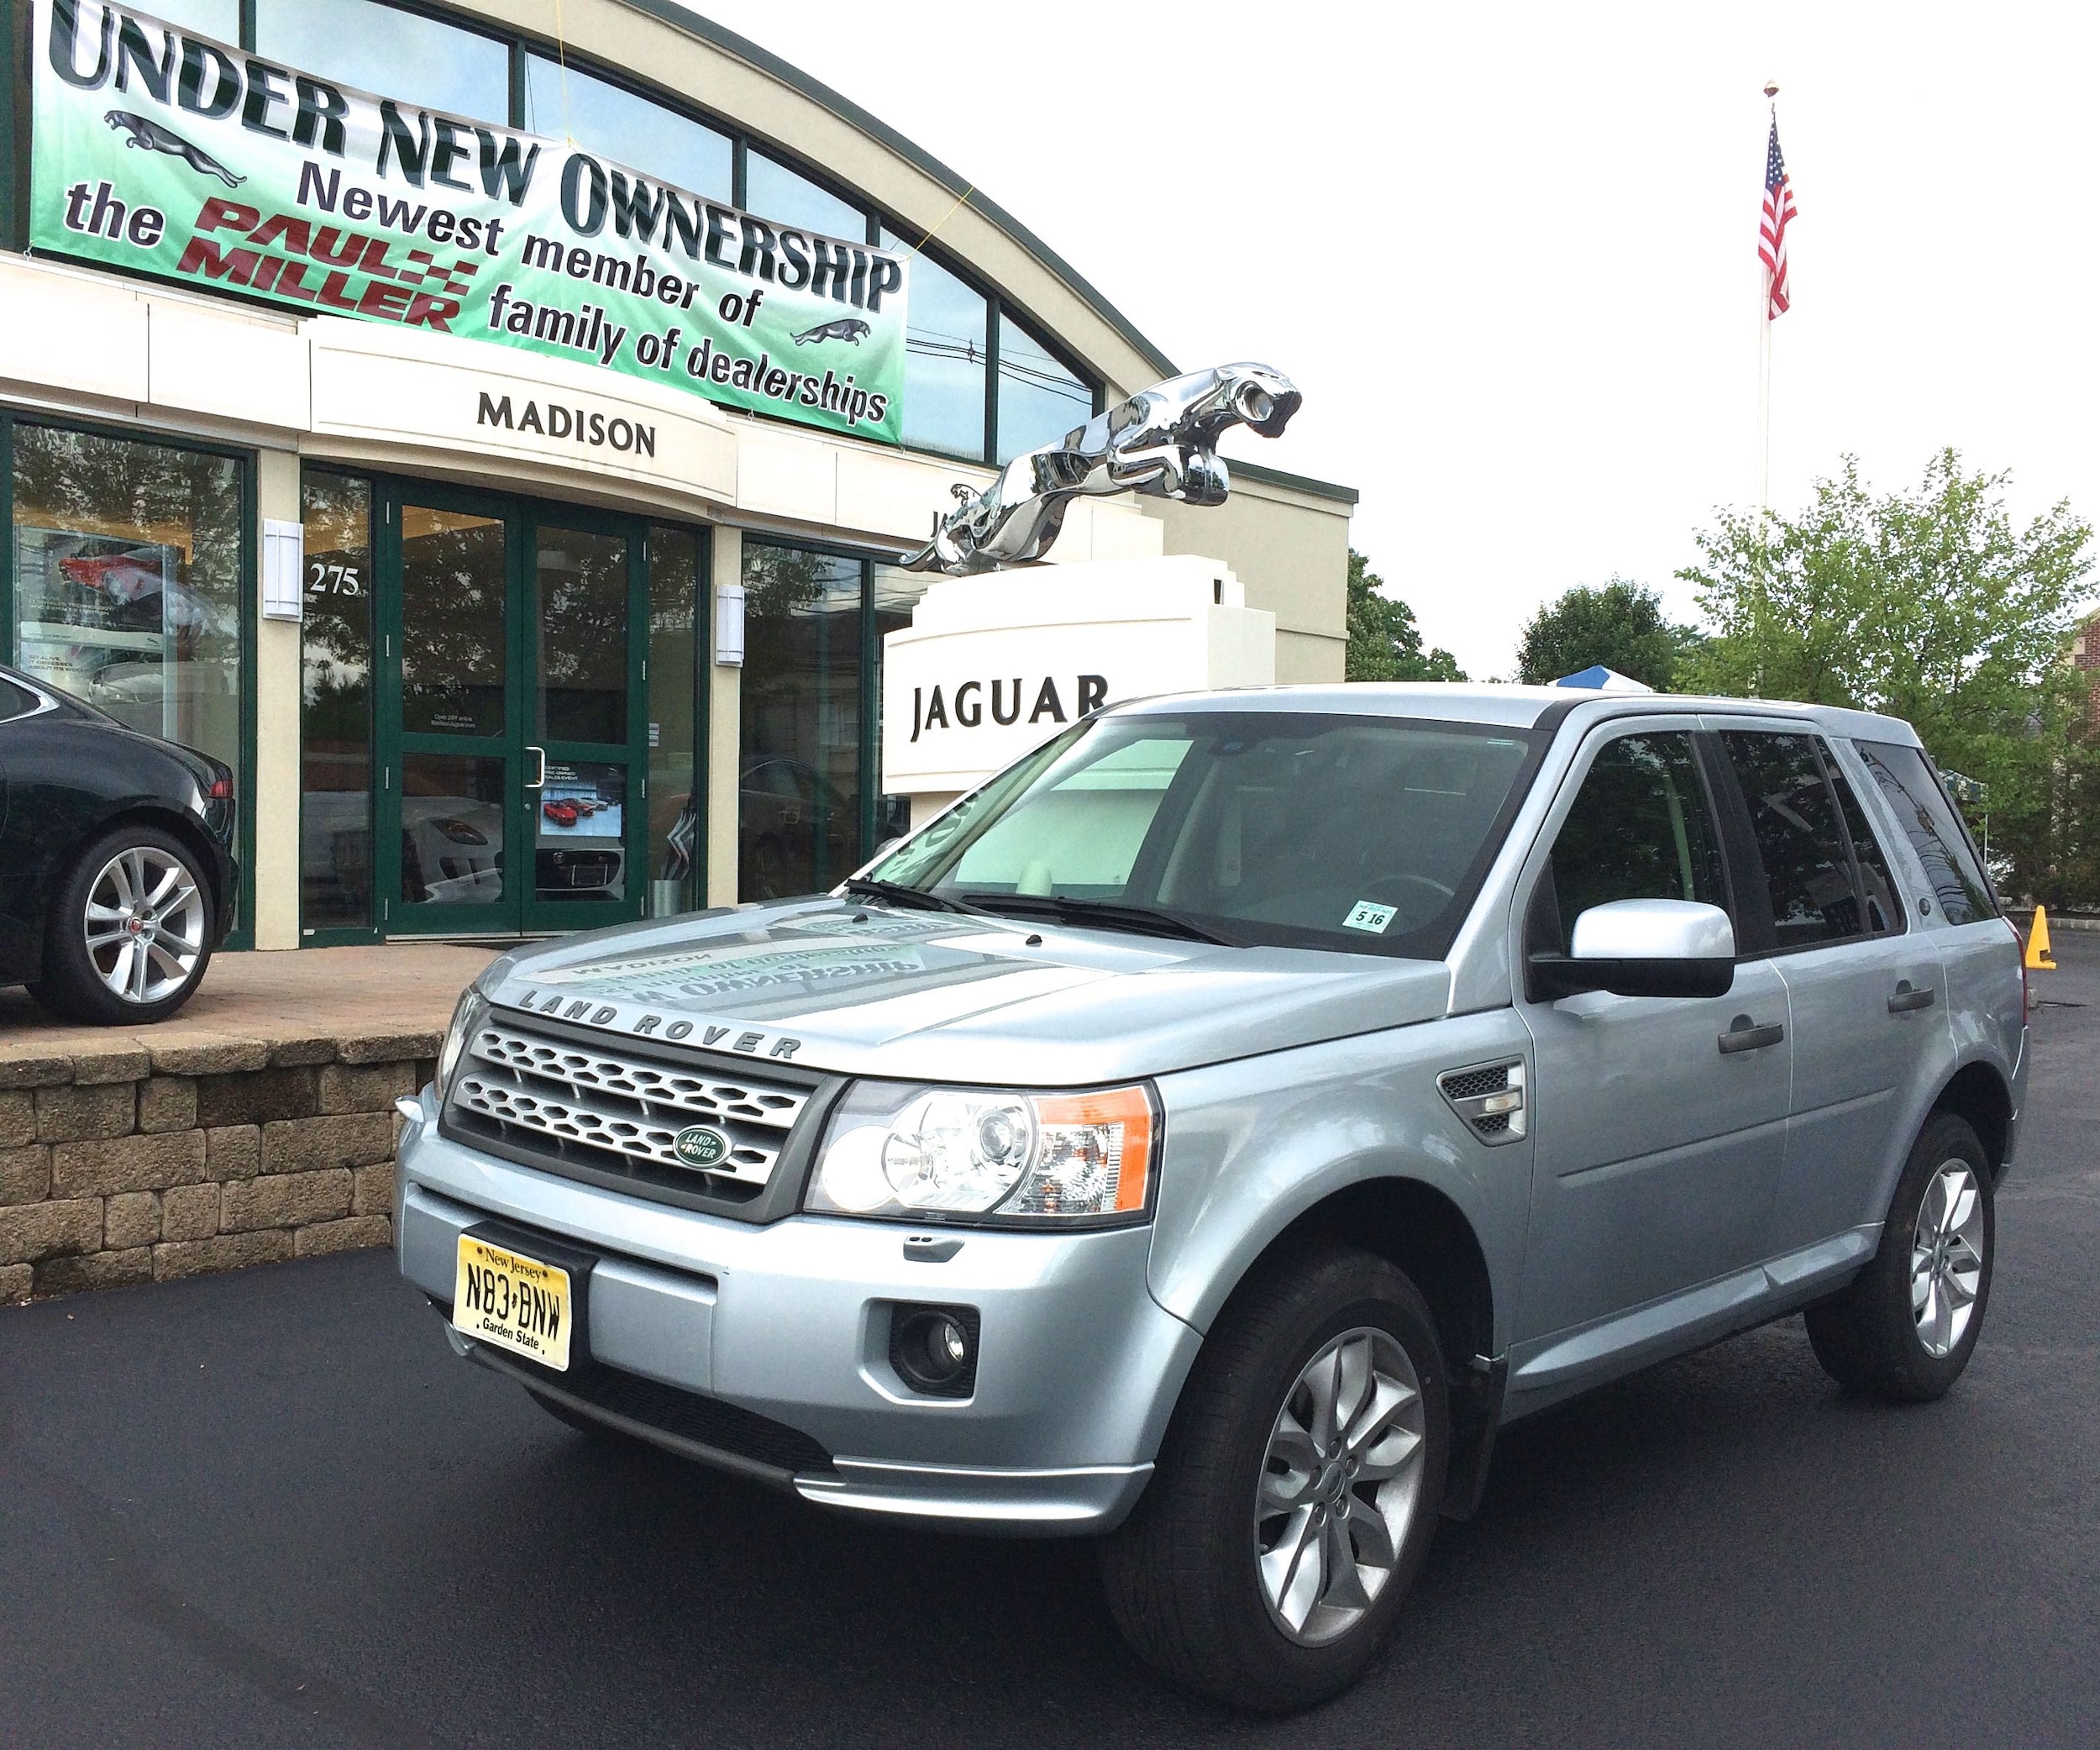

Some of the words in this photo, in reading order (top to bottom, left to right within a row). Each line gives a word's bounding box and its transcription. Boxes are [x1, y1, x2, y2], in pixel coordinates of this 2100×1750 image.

[49, 0, 350, 159] UNDER
[375, 100, 542, 207] NEW
[560, 152, 902, 313] OWNERSHIP
[64, 181, 165, 249] the
[195, 196, 403, 280] PAUL
[297, 160, 505, 257] Newest
[520, 232, 700, 310] member
[718, 289, 764, 328] of
[176, 235, 460, 334] MILLER
[487, 282, 627, 366] family
[635, 325, 680, 371] of
[687, 337, 888, 426] dealerships
[476, 391, 657, 458] MADISON
[310, 563, 359, 596] 275
[911, 675, 1109, 743] JAGUAR
[1356, 912, 1368, 922] 5
[1368, 913, 1385, 925] 16
[519, 991, 617, 1025] LAND
[633, 1015, 801, 1059] ROVER
[685, 1133, 712, 1146] LAND
[685, 1143, 717, 1159] ROVER
[486, 1247, 509, 1268] New
[510, 1256, 542, 1283] Jersey
[483, 1317, 513, 1340] Garden
[516, 1330, 539, 1350] State
